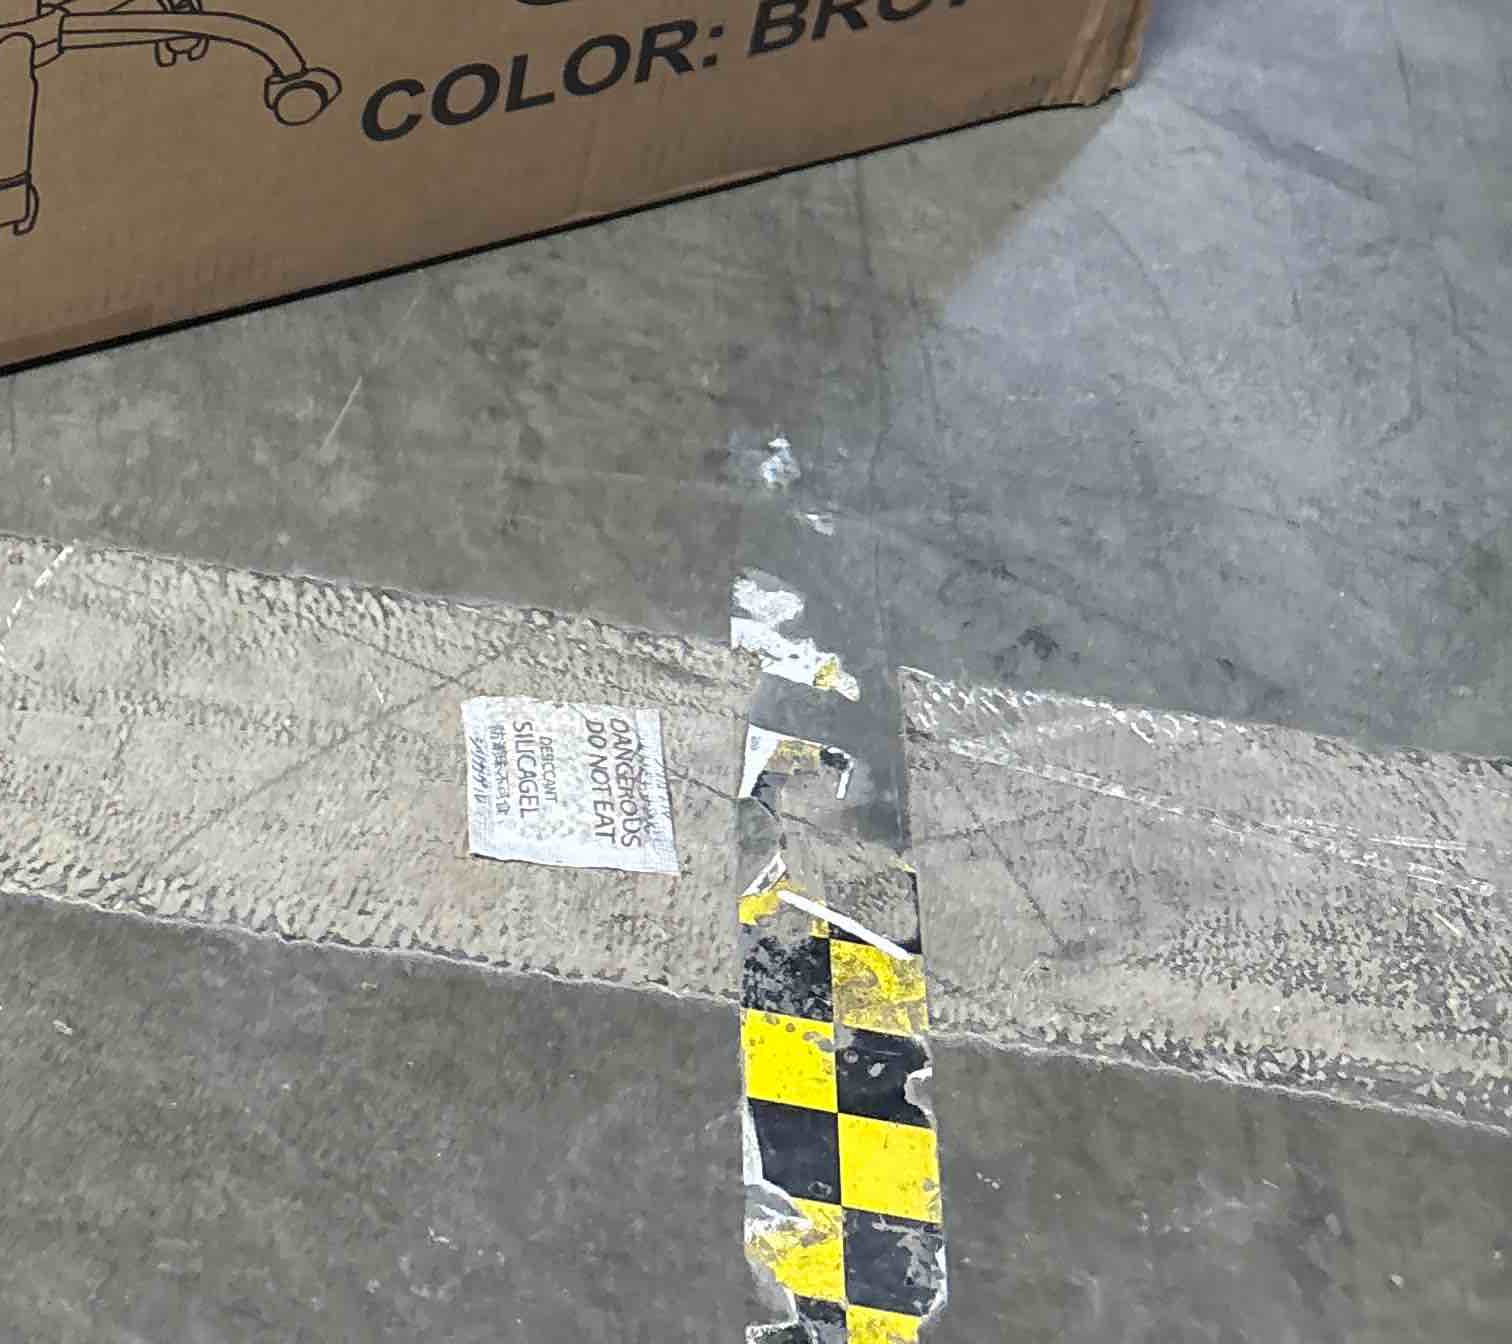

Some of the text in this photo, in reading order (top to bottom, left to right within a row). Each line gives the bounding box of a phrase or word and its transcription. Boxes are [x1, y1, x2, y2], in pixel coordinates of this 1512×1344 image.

[361, 19, 726, 142] COLOR:
[539, 735, 558, 804] DESICCANT
[585, 719, 616, 845] DO NOT EAT
[609, 717, 642, 848] DANGEROUS
